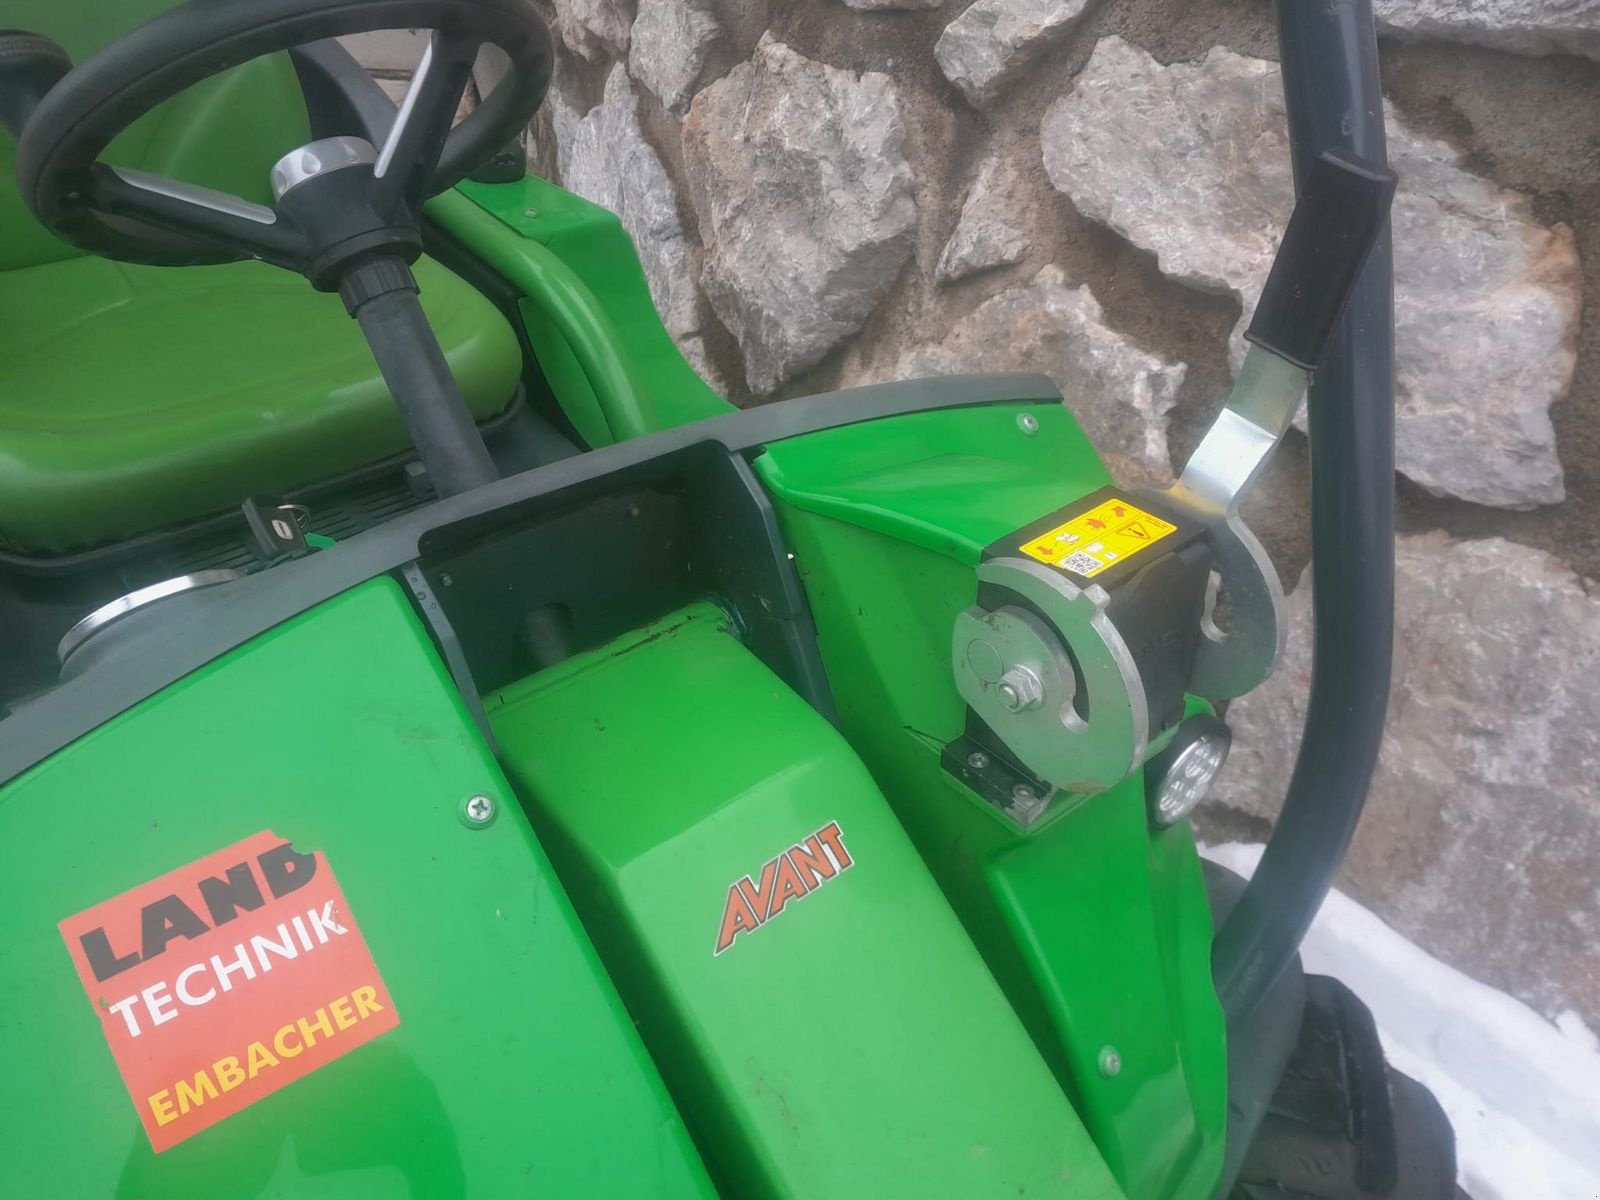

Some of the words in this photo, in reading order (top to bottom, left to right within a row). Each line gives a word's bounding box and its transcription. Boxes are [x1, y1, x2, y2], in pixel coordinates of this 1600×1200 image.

[79, 842, 317, 982] LAND
[713, 820, 855, 957] AVANT
[109, 900, 348, 1038] TECHNIK
[147, 985, 384, 1127] EMBACHER
